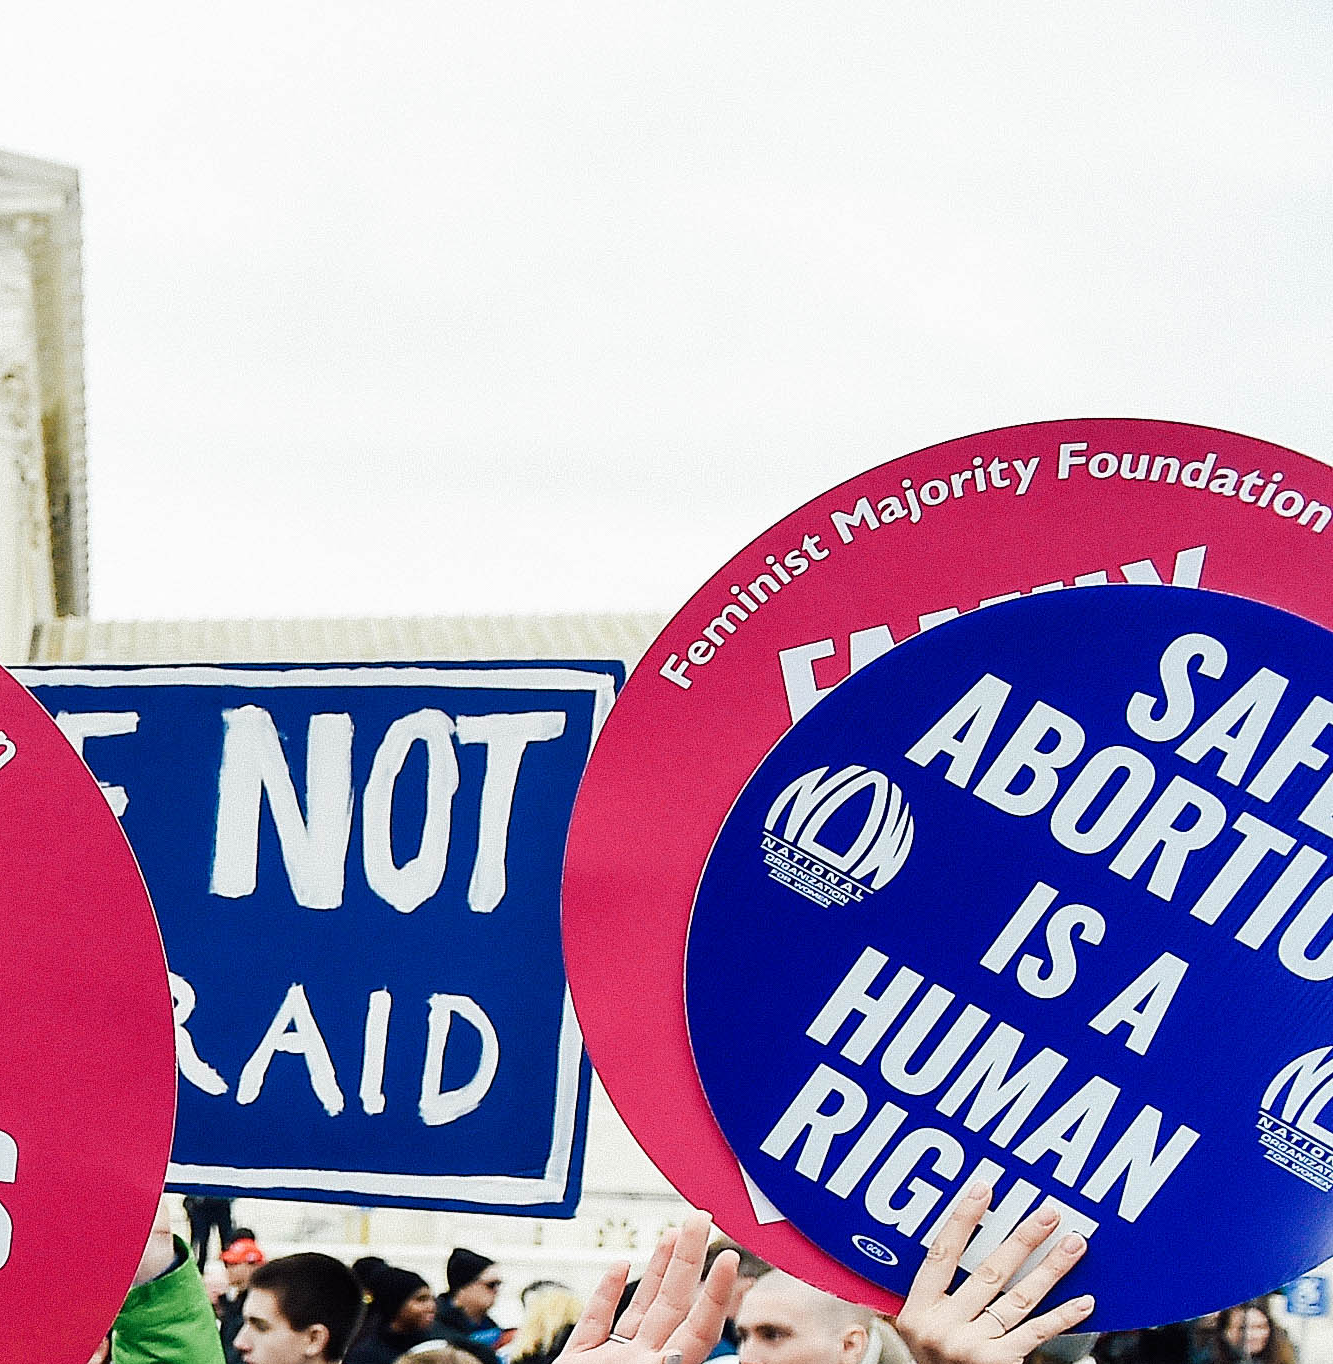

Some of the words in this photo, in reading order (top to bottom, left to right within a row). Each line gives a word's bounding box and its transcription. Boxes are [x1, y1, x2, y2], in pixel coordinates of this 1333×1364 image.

[660, 535, 829, 689] Feminist
[831, 457, 1039, 543] Majority
[1058, 443, 1333, 533] Foundation
[211, 705, 566, 913] NOT
[761, 837, 864, 901] NATIONAL
[764, 764, 916, 890] NOW
[765, 853, 850, 905] ORGANIZATION
[770, 868, 790, 883] FOR
[793, 881, 832, 906] WOMEN
[979, 882, 1107, 999] IS
[1089, 952, 1189, 1055] A
[806, 947, 1200, 1222] HUMAN
[760, 1064, 1100, 1292] RIGHT
[1265, 1149, 1289, 1165] FOR
[1291, 1162, 1332, 1190] WOMEN
